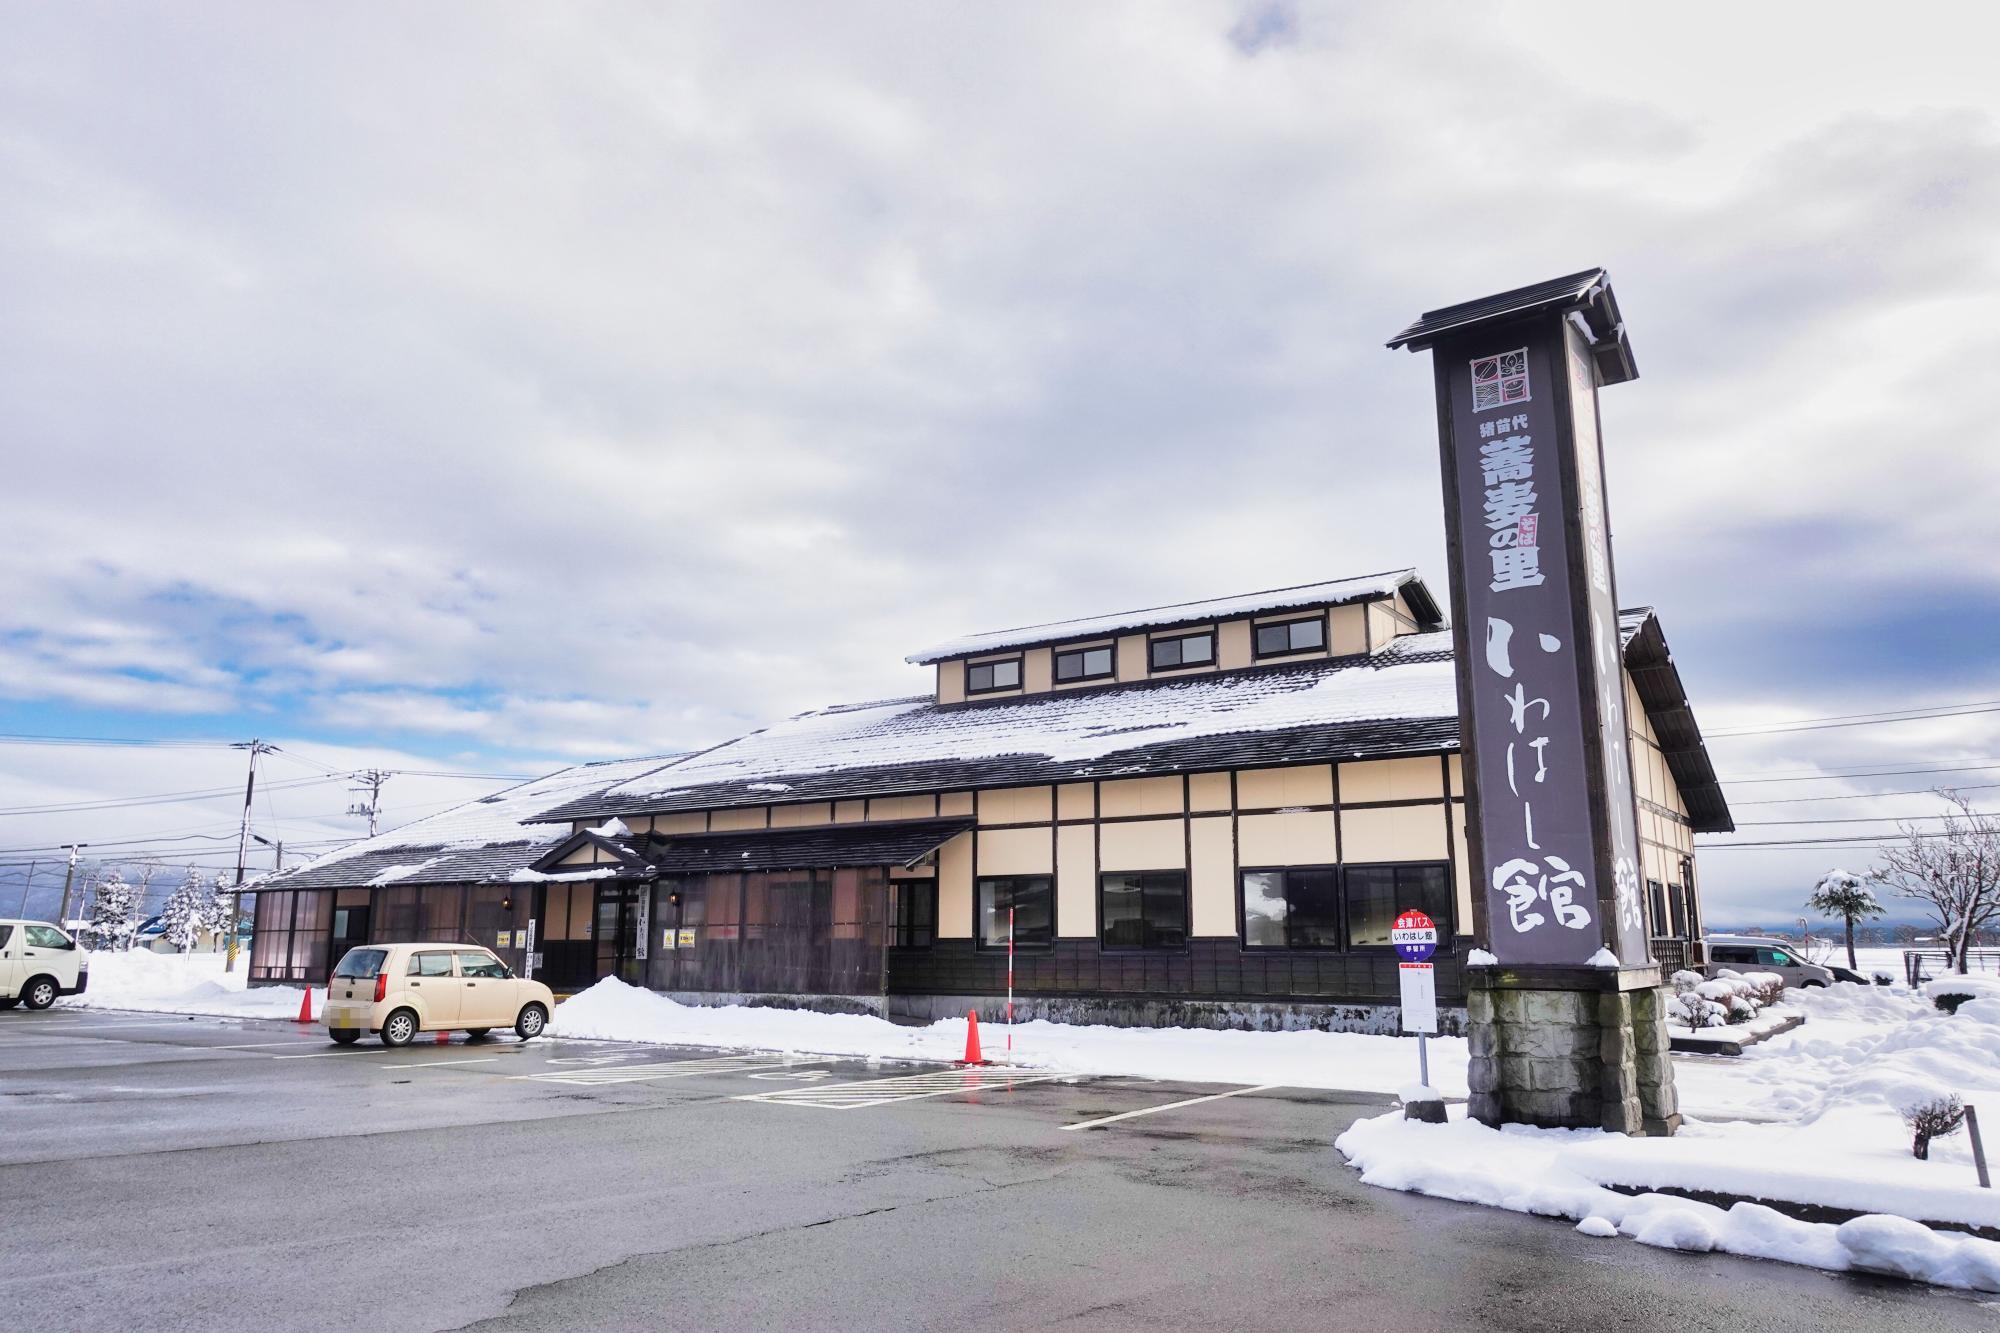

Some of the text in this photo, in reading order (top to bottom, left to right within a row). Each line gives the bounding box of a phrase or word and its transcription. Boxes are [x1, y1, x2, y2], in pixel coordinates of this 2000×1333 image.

[1480, 414, 1528, 438] 猪苗代
[1479, 435, 1546, 592] 蕎麦の里
[1518, 516, 1538, 546] そば
[1486, 616, 1589, 933] いわはし館
[1394, 931, 1433, 940] いわはし館
